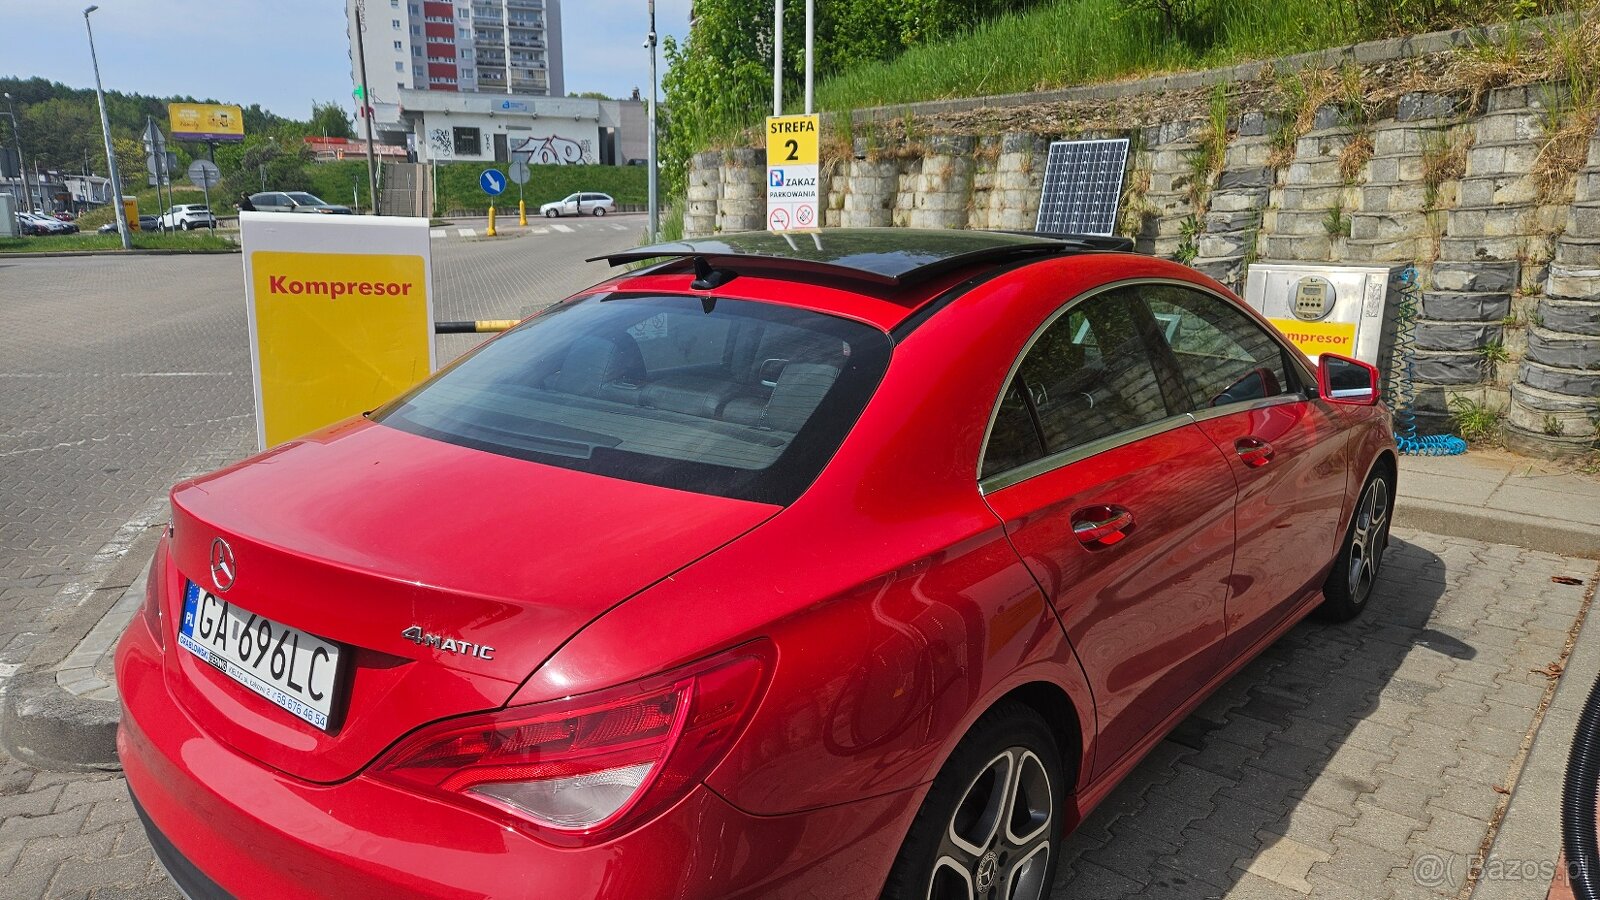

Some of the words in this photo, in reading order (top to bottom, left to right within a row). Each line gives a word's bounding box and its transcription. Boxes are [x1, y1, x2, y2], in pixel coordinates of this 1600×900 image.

[770, 120, 814, 134] STREFA
[785, 139, 798, 160] 2
[785, 177, 815, 187] ZAKAZ
[769, 190, 815, 198] PARKOWANIA
[269, 275, 412, 300] Kompresor
[1285, 332, 1349, 345] mpresor
[185, 611, 194, 627] PL
[199, 592, 229, 651] GA
[238, 613, 330, 701] 696LC
[401, 625, 496, 661] 4MATIC
[287, 699, 302, 715] 676
[303, 708, 313, 721] 46
[314, 713, 325, 727] 54
